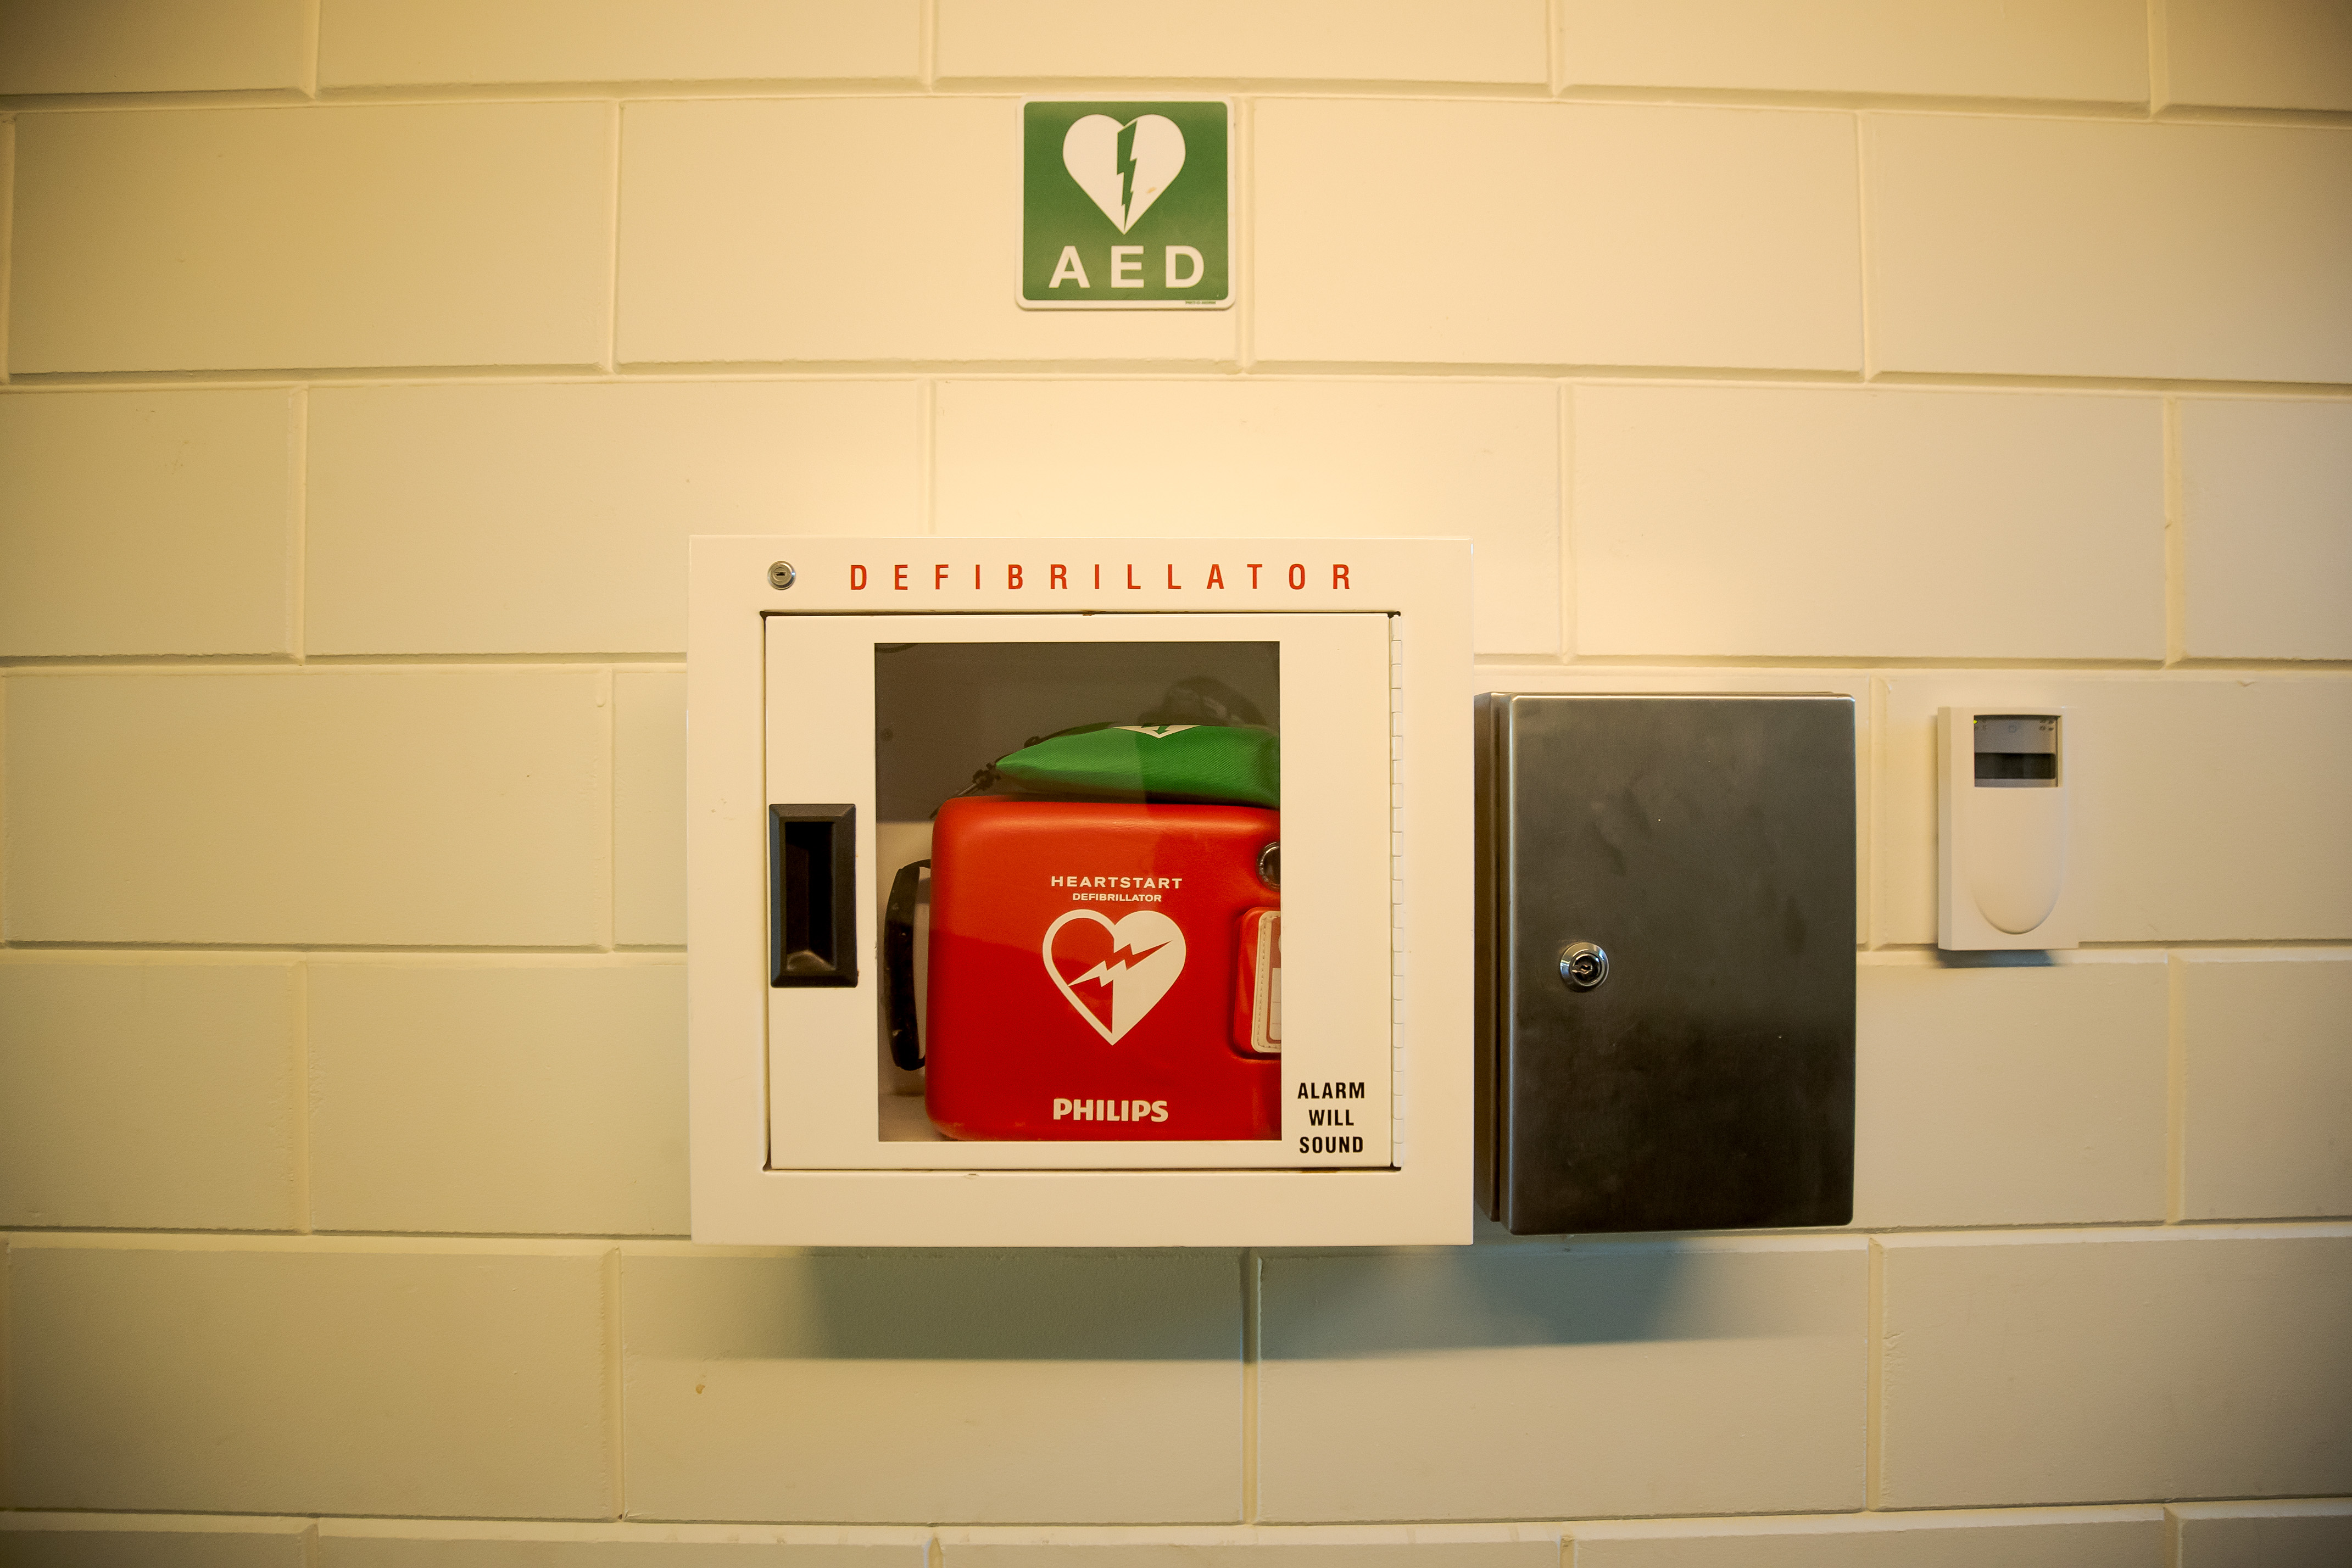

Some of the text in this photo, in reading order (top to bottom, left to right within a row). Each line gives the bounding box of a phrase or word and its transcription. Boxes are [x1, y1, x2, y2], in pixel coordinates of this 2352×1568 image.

[1048, 245, 1205, 288] AED
[850, 563, 1351, 590] DEFIBRILLATOR
[1051, 875, 1183, 889] HEARTSTART
[1072, 892, 1162, 902] DEFIBRILLATOR
[1297, 1082, 1366, 1099] ALARM
[1053, 1097, 1169, 1123] PHILIPS
[1308, 1109, 1355, 1126] WILL
[1299, 1136, 1363, 1153] SOUND
